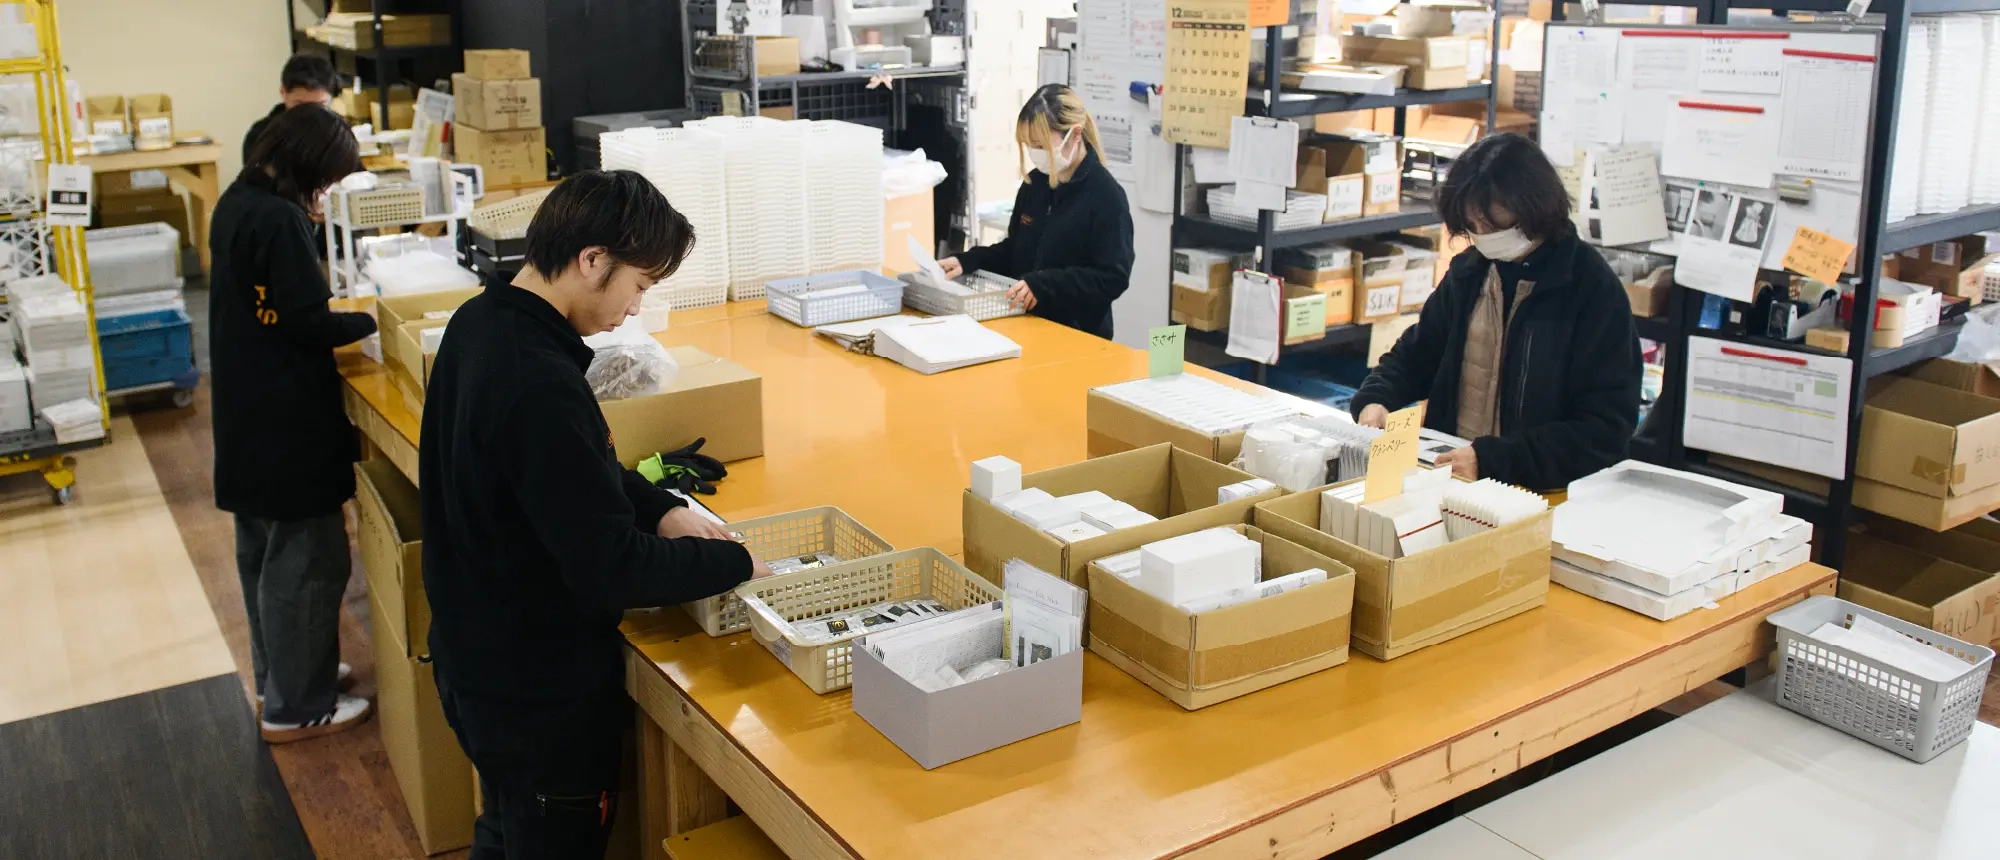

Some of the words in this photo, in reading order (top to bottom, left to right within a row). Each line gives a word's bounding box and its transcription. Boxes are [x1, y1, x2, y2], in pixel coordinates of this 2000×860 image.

[1172, 7, 1182, 18] 12
[1386, 412, 1415, 433] ローズ
